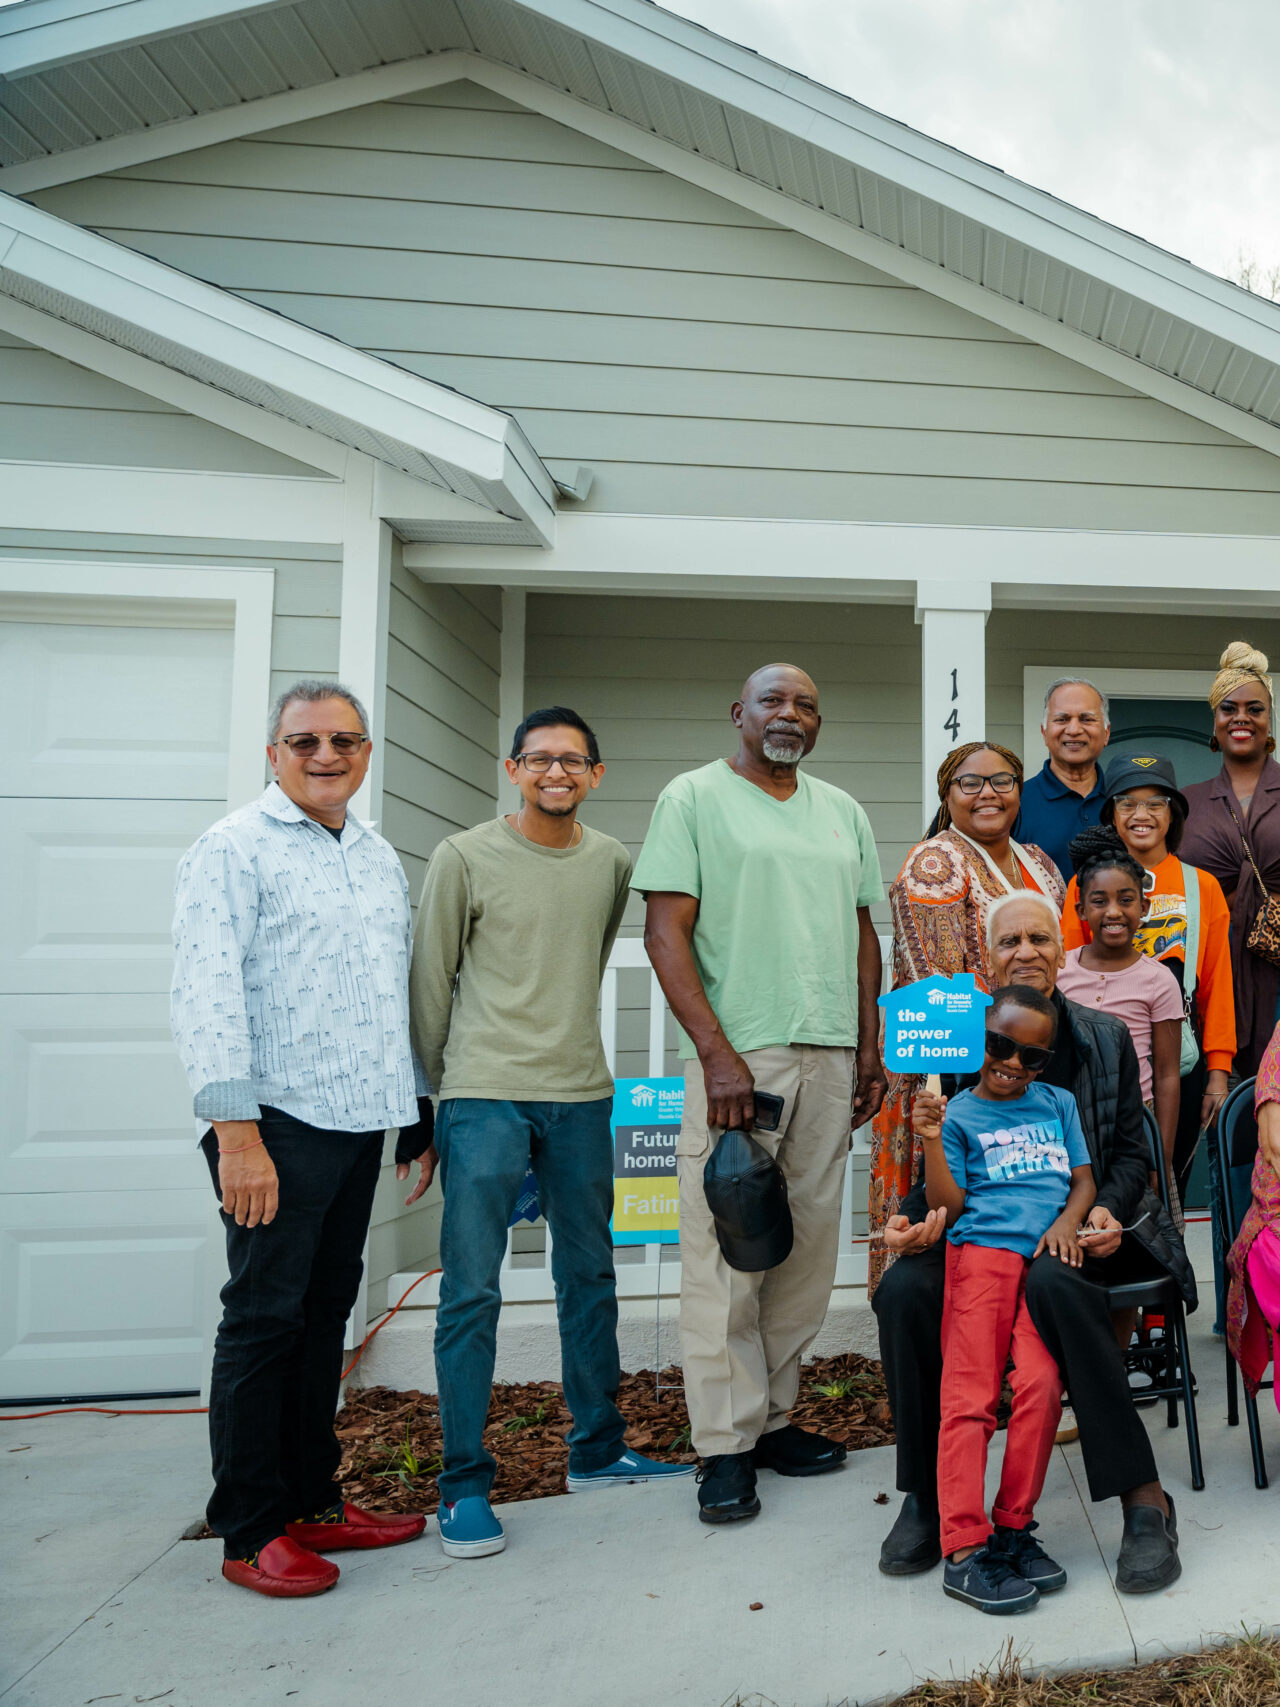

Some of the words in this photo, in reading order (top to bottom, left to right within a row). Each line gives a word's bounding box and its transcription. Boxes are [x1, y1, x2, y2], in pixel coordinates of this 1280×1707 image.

[897, 1009, 926, 1022] the
[897, 1029, 952, 1043] power
[896, 1044, 915, 1058] of
[920, 1044, 969, 1058] home
[624, 1152, 677, 1169] home
